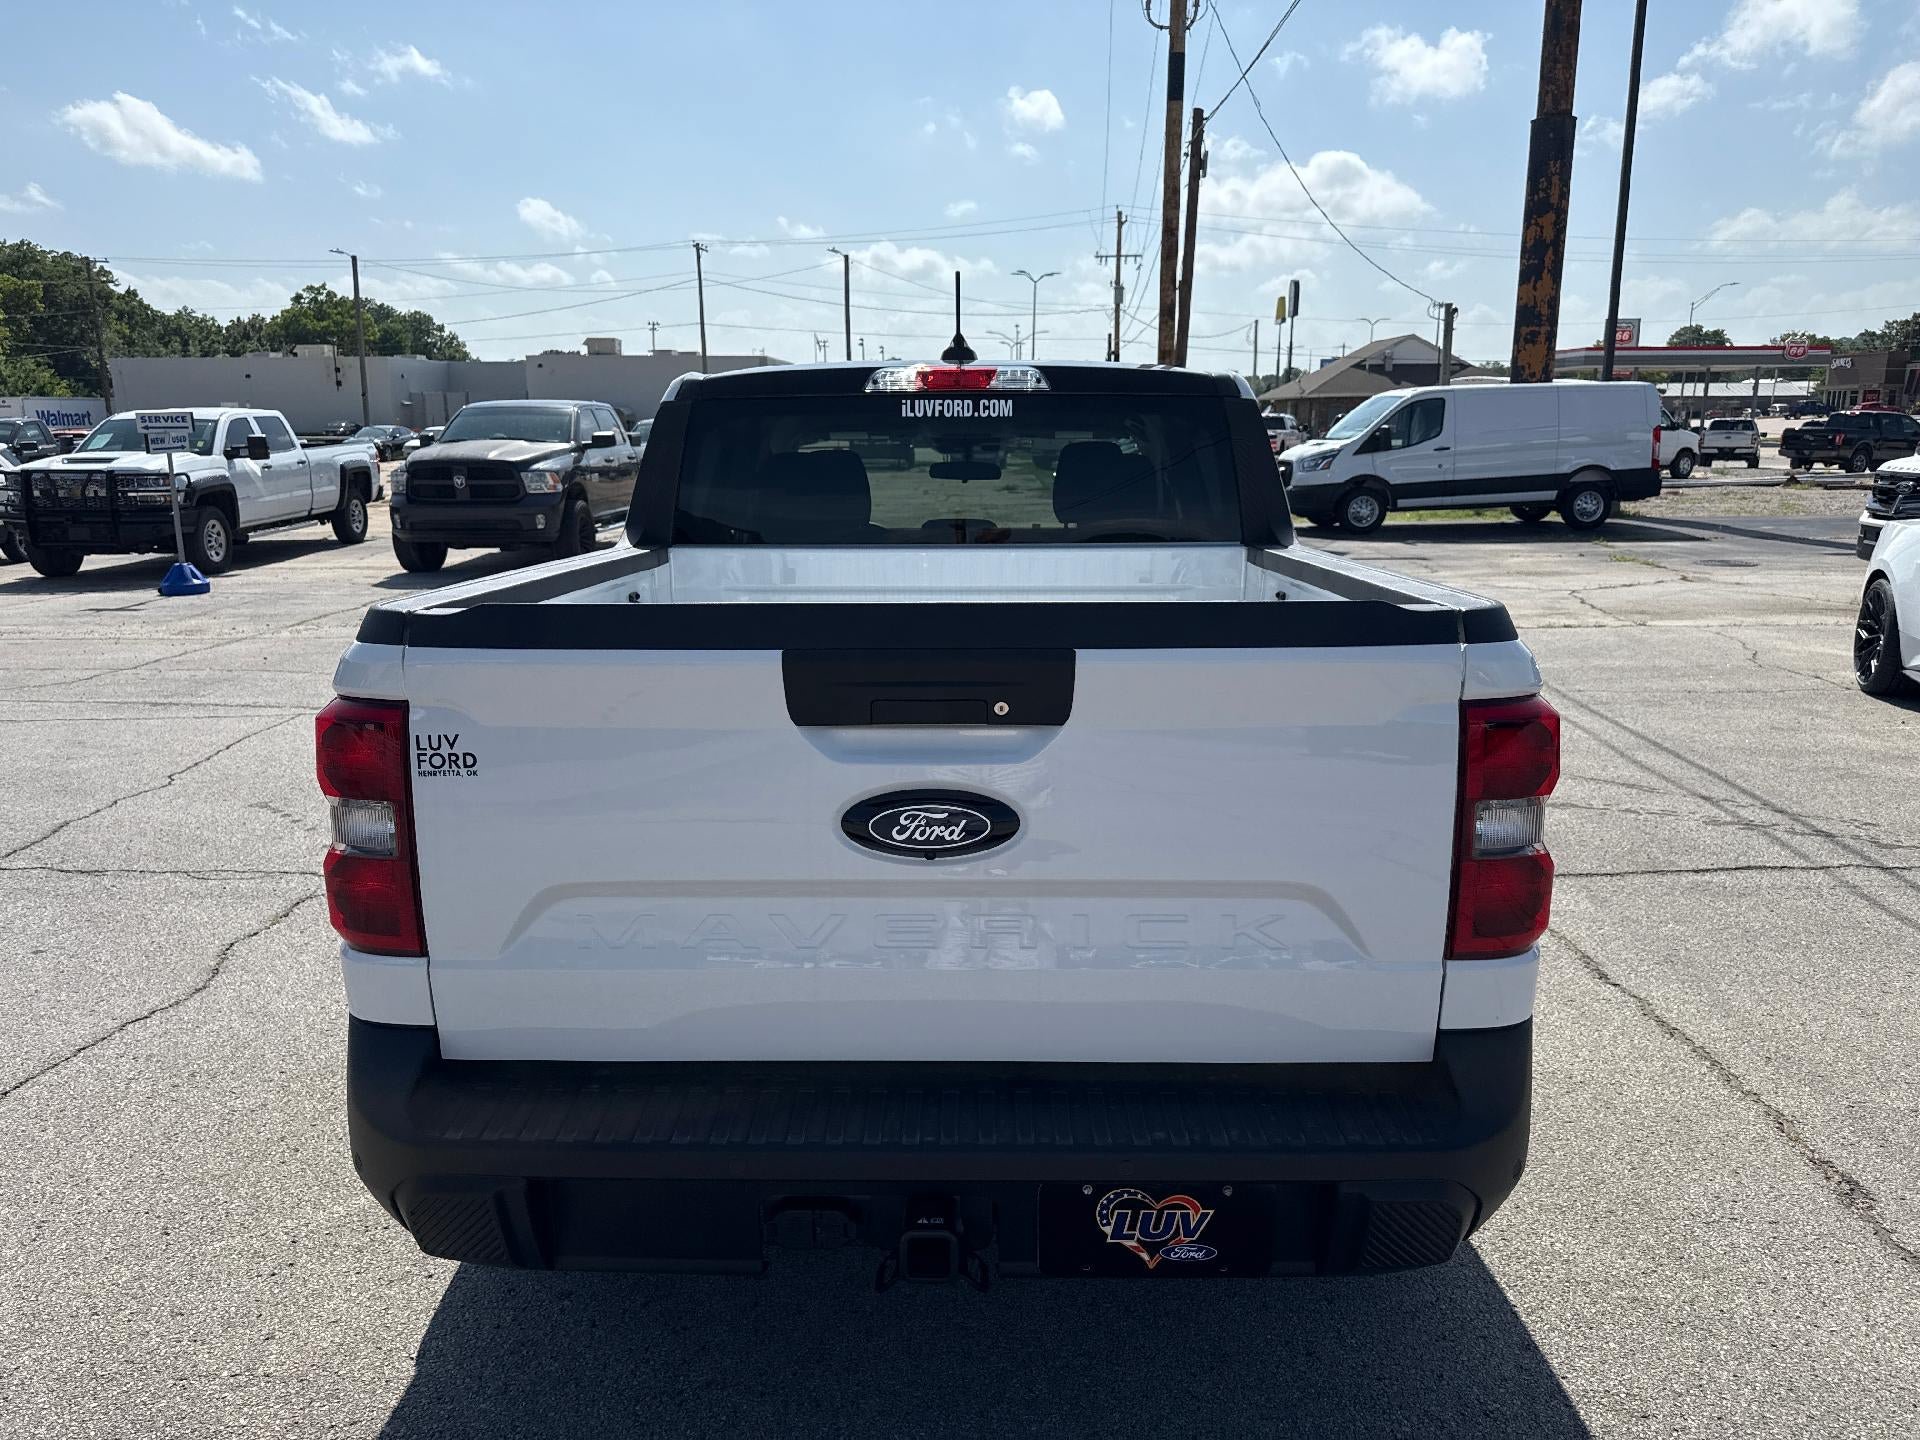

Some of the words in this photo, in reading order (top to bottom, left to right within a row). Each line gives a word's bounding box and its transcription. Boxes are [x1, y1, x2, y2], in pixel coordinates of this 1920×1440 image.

[1789, 347, 1804, 356] 66
[35, 409, 93, 426] Walmart
[901, 399, 1013, 418] iLUVFORD.COM
[140, 415, 188, 424] SERVICE
[150, 437, 166, 445] NEW
[171, 435, 187, 443] USED
[415, 733, 460, 752] LUV
[416, 751, 478, 770] FORD
[417, 769, 464, 778] HENRYETTA,
[466, 769, 479, 777] OK
[891, 810, 968, 841] Ford
[574, 912, 1291, 952] MAVERICK
[1106, 1209, 1216, 1243] LUV
[1170, 1246, 1206, 1260] Ford
